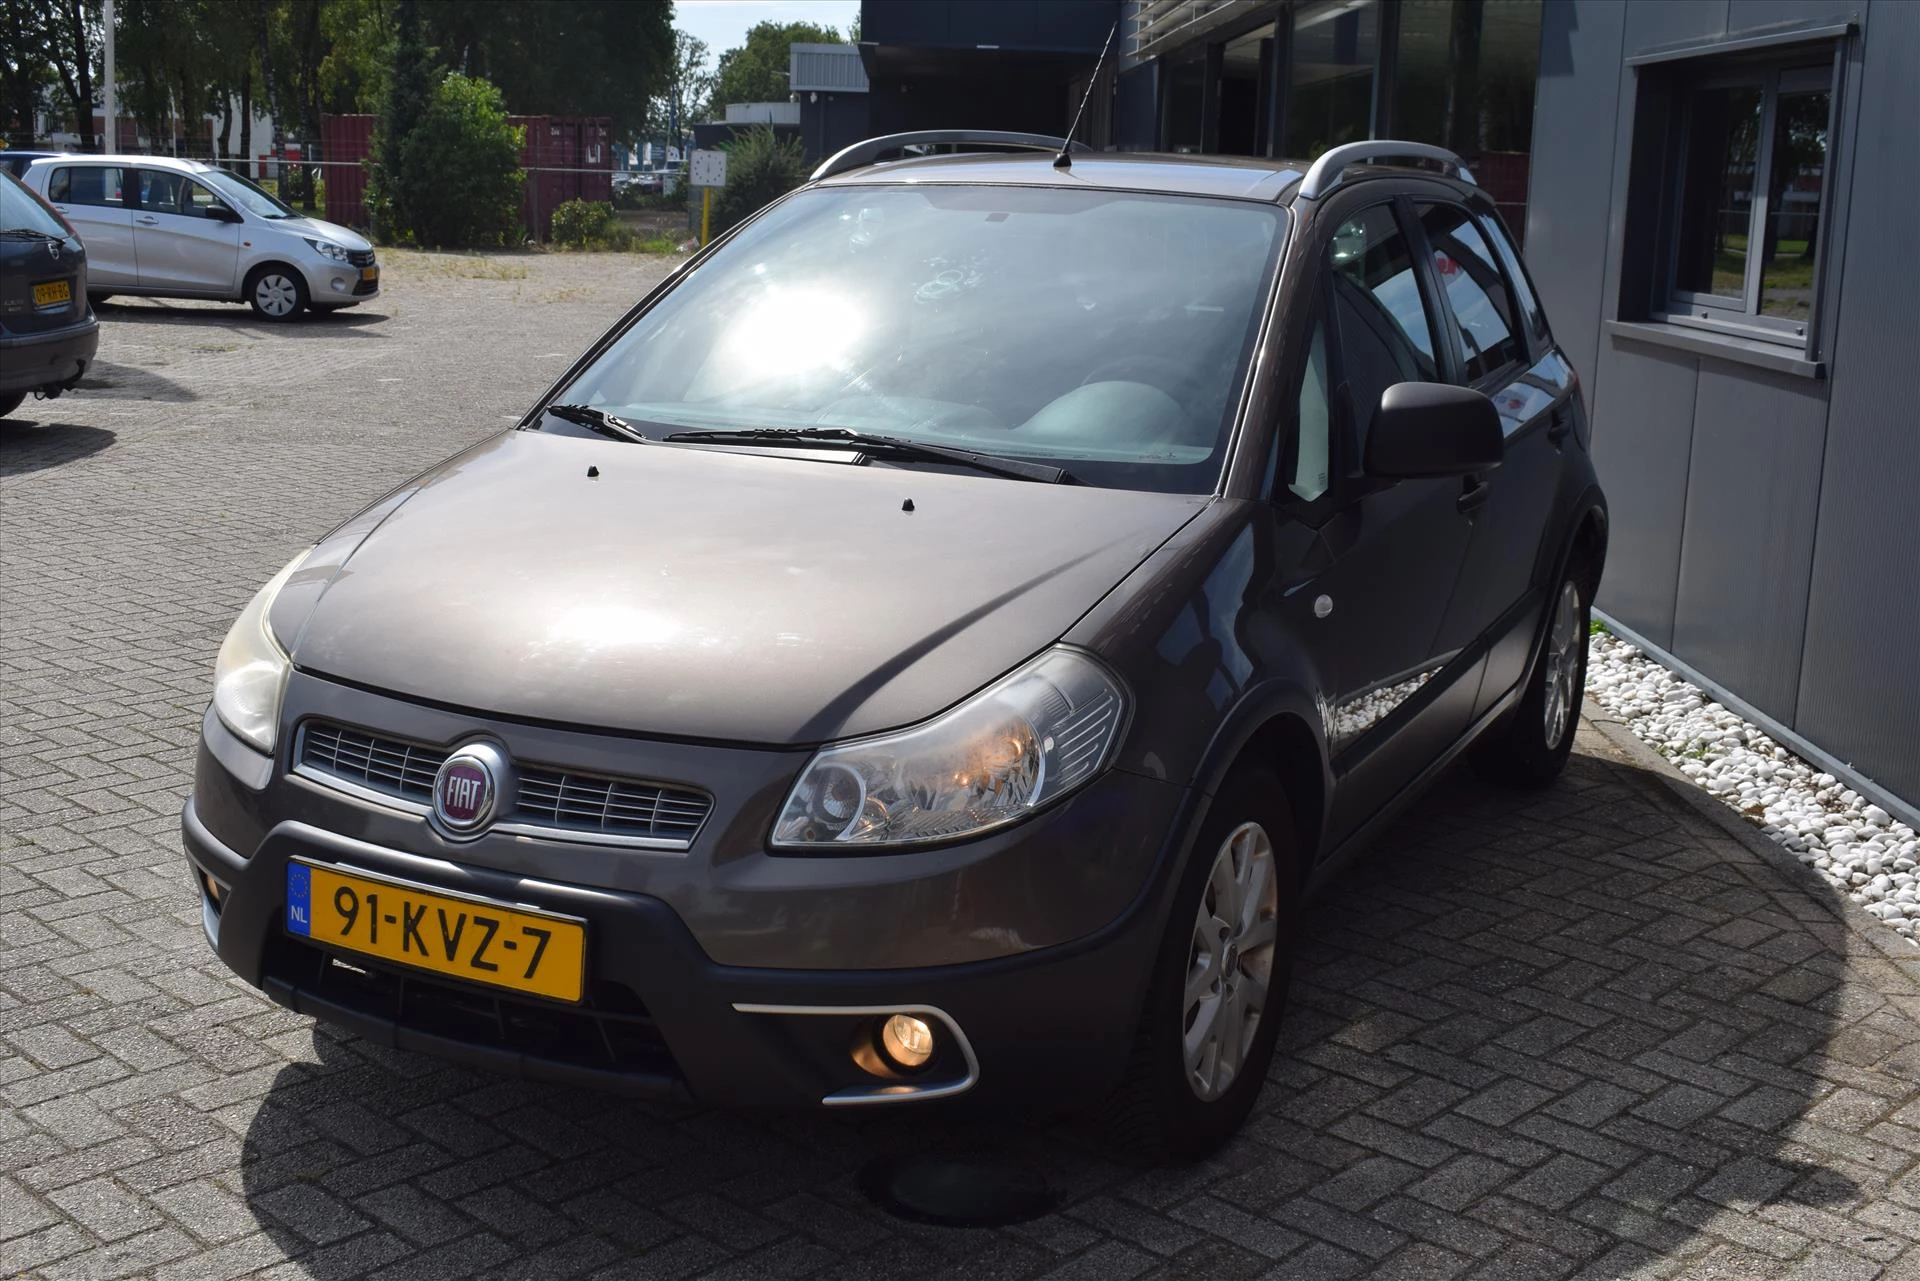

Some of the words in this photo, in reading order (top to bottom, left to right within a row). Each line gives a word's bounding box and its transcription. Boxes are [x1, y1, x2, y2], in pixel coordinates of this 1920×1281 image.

[446, 776, 481, 810] FIAT
[291, 904, 308, 924] NL
[334, 886, 552, 980] 91-KVZ-7
